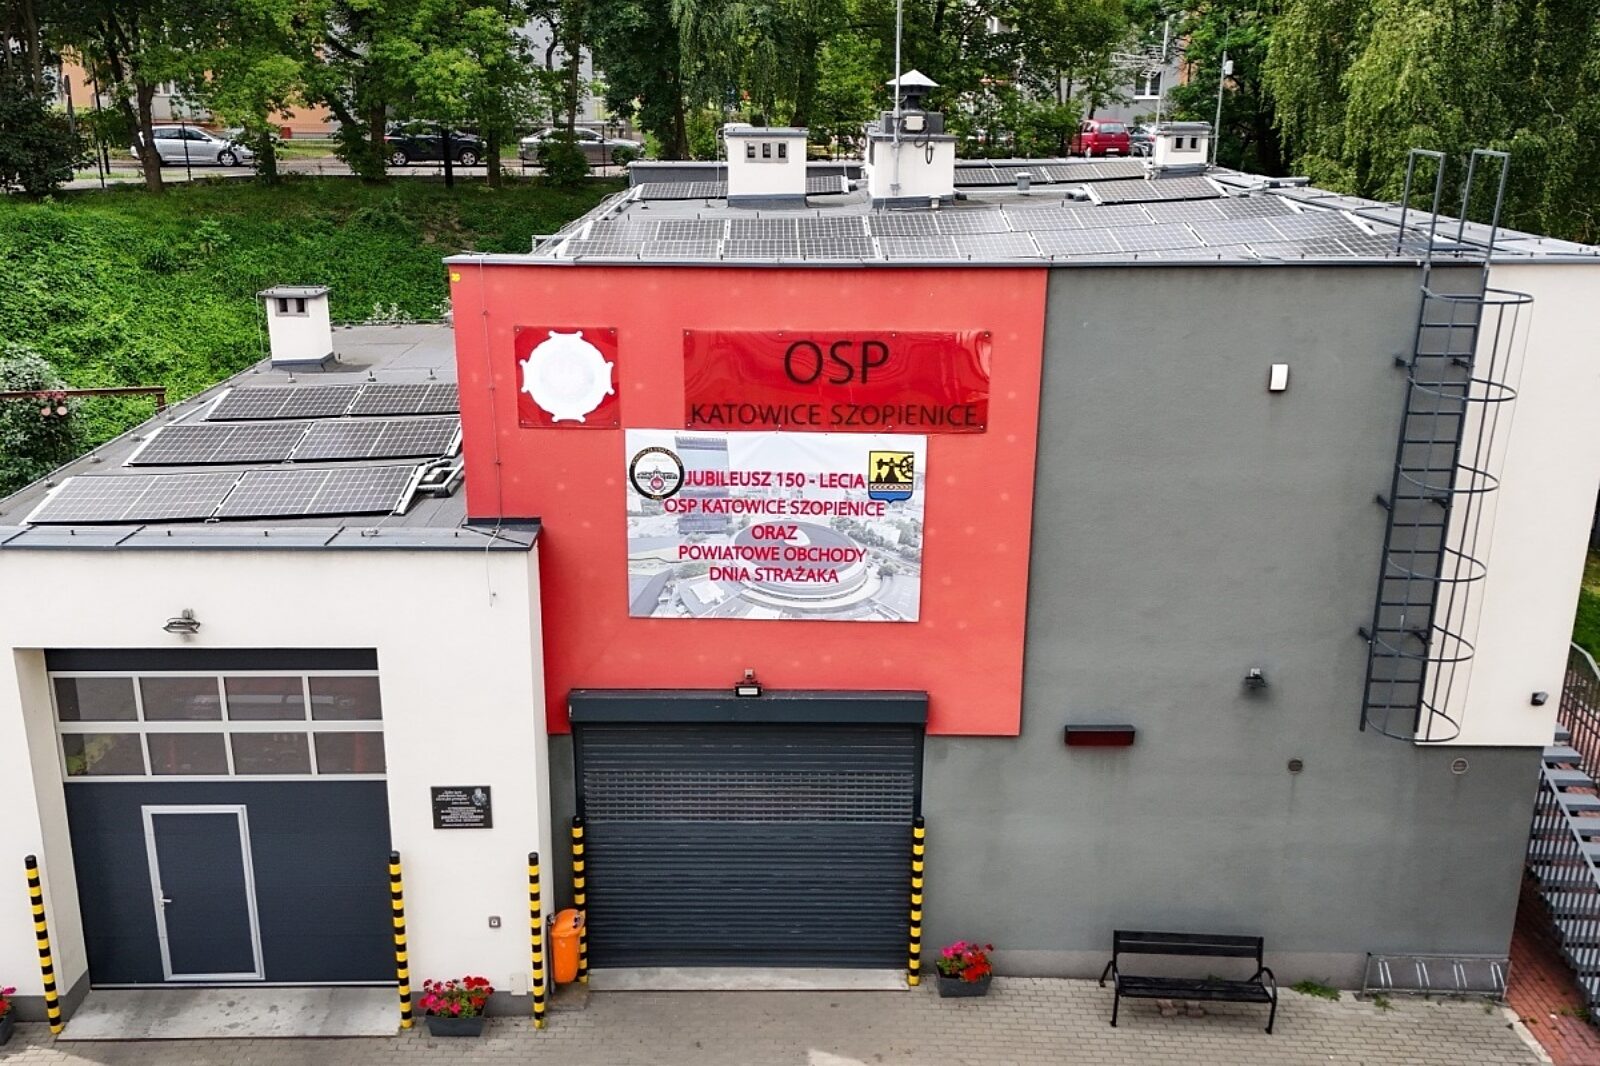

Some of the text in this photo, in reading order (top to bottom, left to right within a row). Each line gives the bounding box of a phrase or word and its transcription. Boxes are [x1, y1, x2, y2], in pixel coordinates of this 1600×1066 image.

[784, 340, 889, 385] OSP
[691, 403, 977, 427] KATOWICE SZOPIENICE
[685, 470, 771, 487] JUBILEUSZ
[777, 472, 805, 487] 150
[820, 473, 865, 489] LECIA
[664, 498, 885, 516] OSP KATOWICE SZOPIENICE
[751, 525, 798, 540] ORAZ
[679, 545, 867, 562] POWIATOWE OBCHODY
[710, 565, 839, 583] DNIA STRAŻAKA
